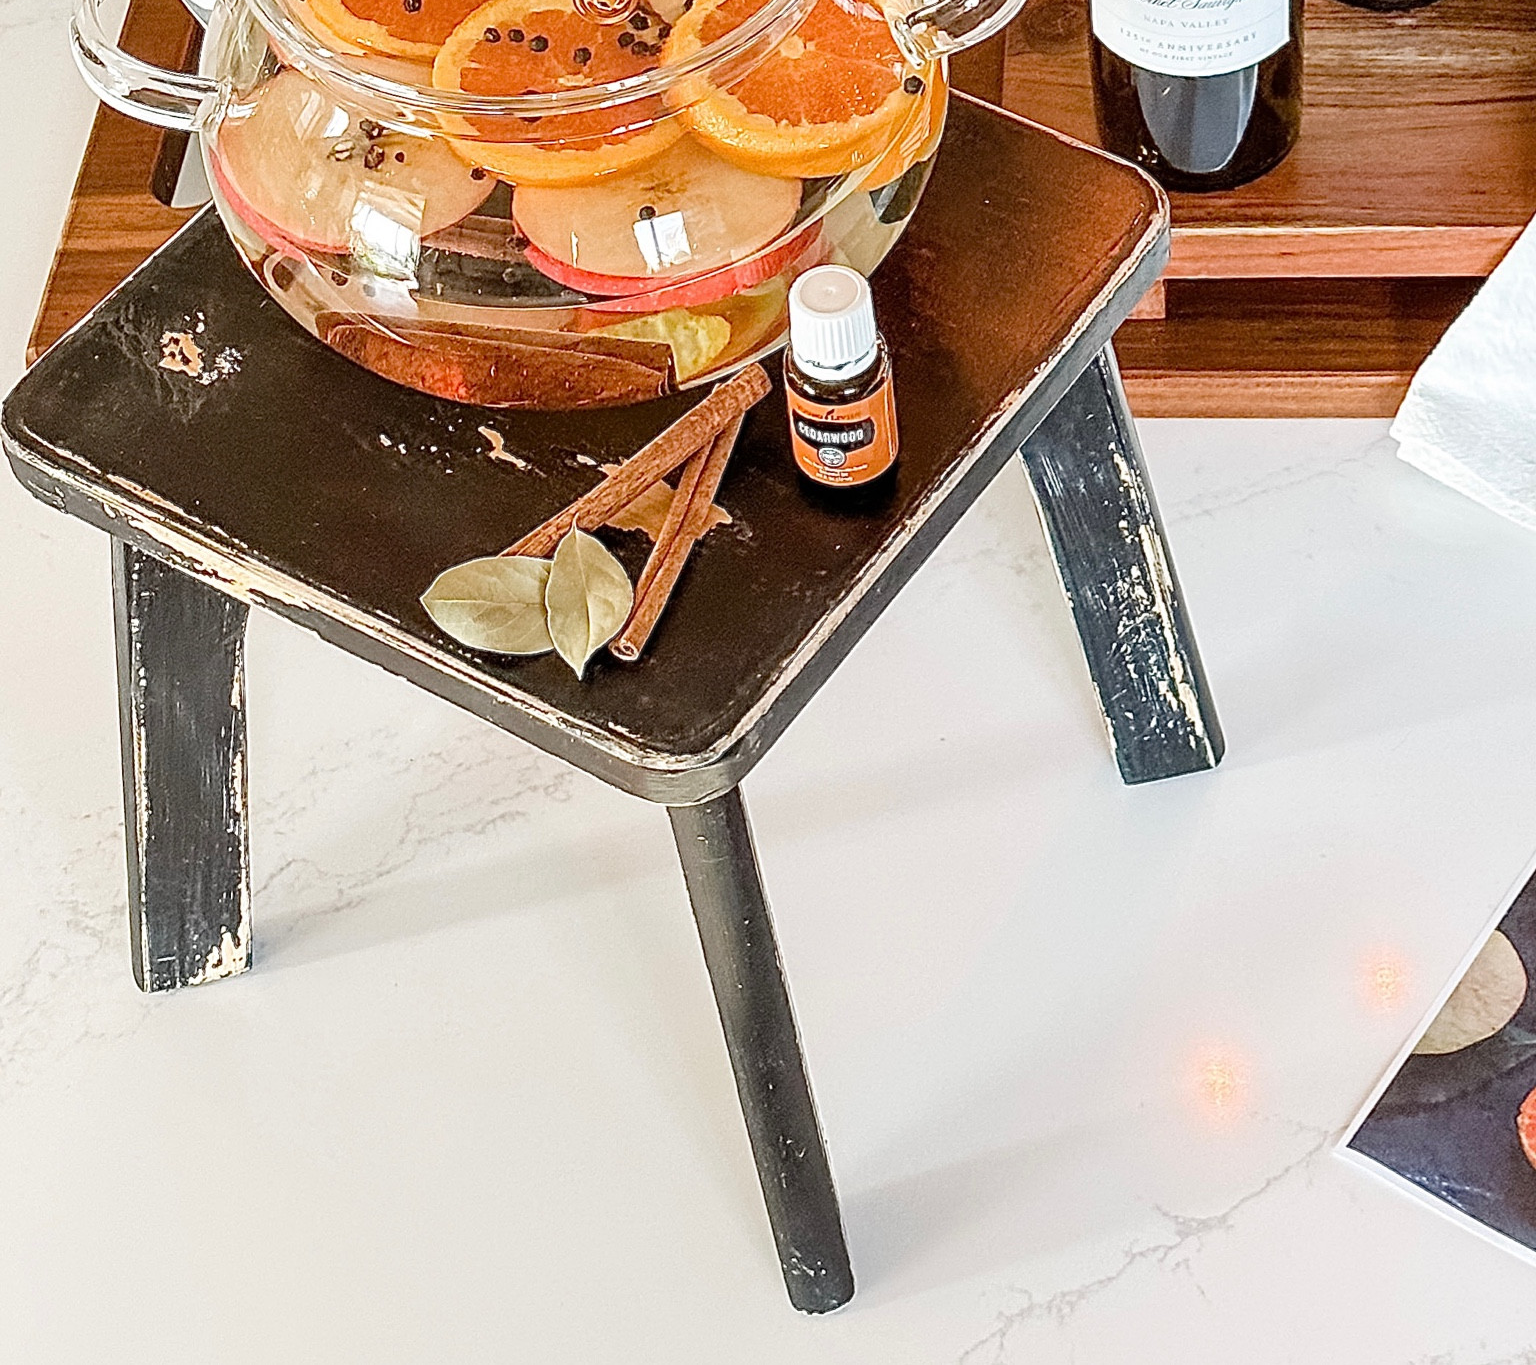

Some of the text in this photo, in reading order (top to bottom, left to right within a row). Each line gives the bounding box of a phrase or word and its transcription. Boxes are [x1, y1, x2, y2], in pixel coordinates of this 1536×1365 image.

[1143, 13, 1230, 29] NAPA VALLEY
[1157, 31, 1258, 53] ANNIVERSARY
[798, 421, 865, 445] CEDARWOOD
